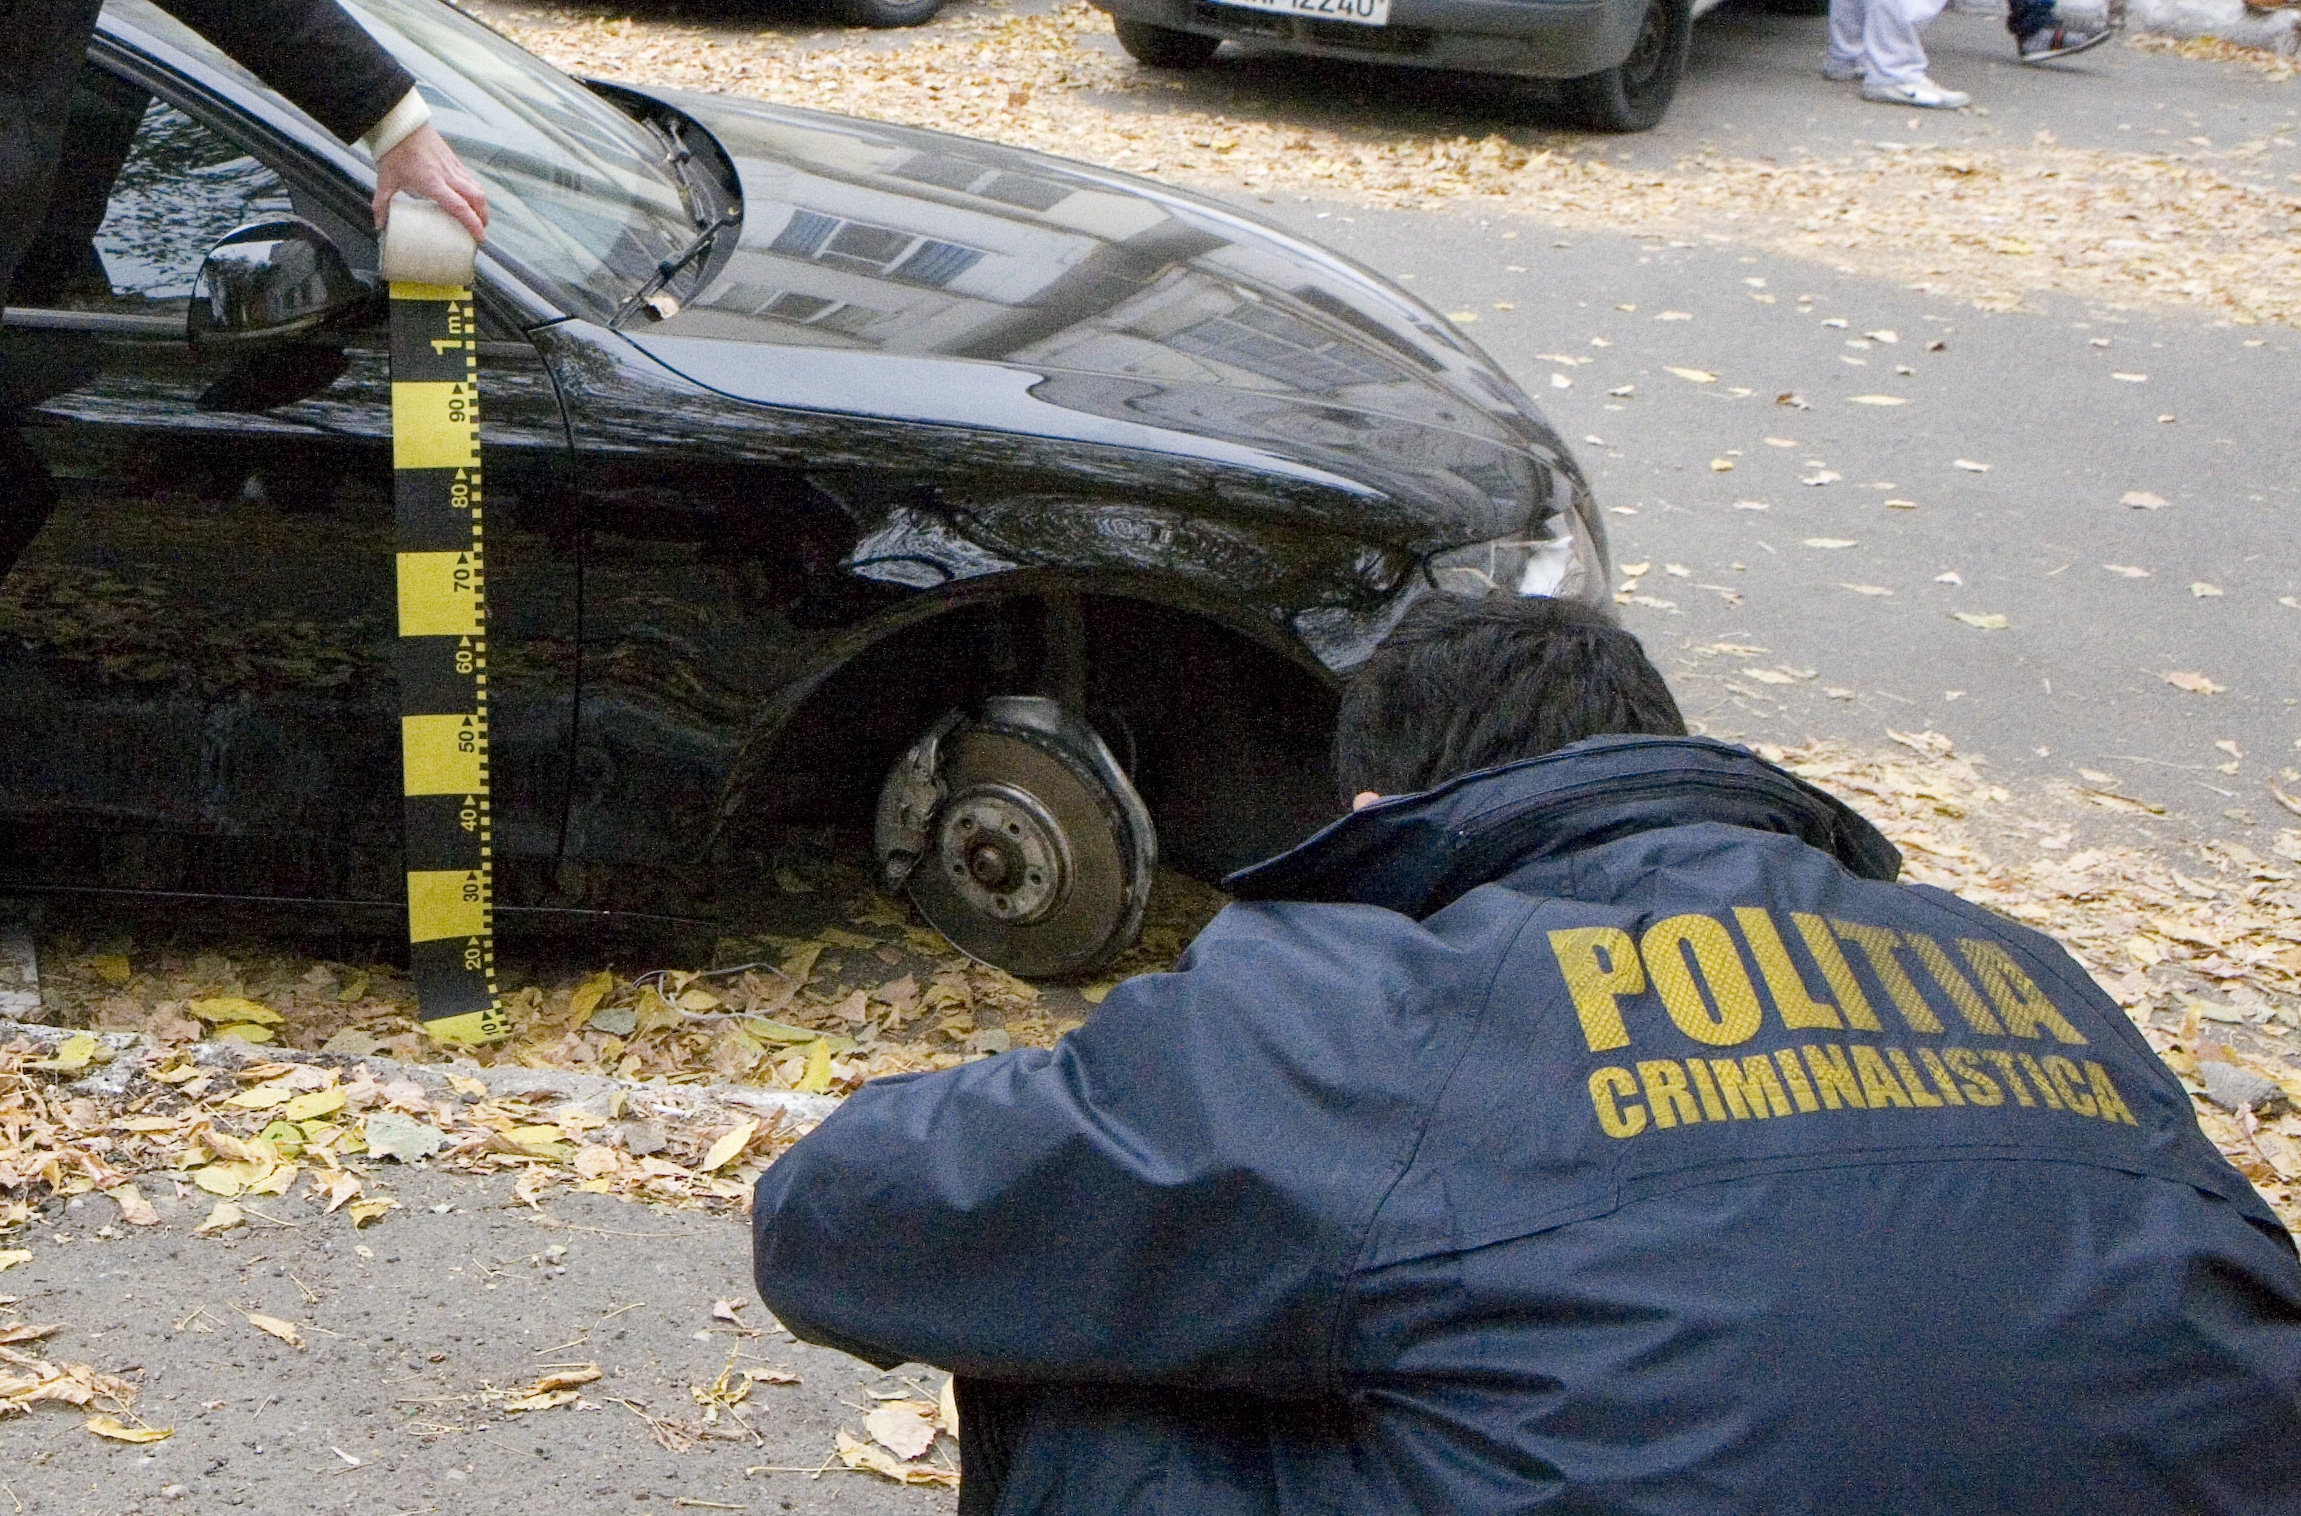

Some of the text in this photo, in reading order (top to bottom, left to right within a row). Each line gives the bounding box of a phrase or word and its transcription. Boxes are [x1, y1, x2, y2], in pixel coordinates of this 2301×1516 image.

[448, 399, 466, 423] 90
[450, 483, 469, 509] 80
[453, 568, 471, 593] 70
[455, 650, 473, 675] 60
[458, 730, 475, 754] 50
[460, 808, 478, 832] 40
[462, 883, 479, 903] 30
[464, 948, 482, 971] 20
[1546, 905, 2090, 1053] POLITIA
[480, 1022, 500, 1037] 10
[1587, 1043, 2139, 1140] CRIMINALISTICA
